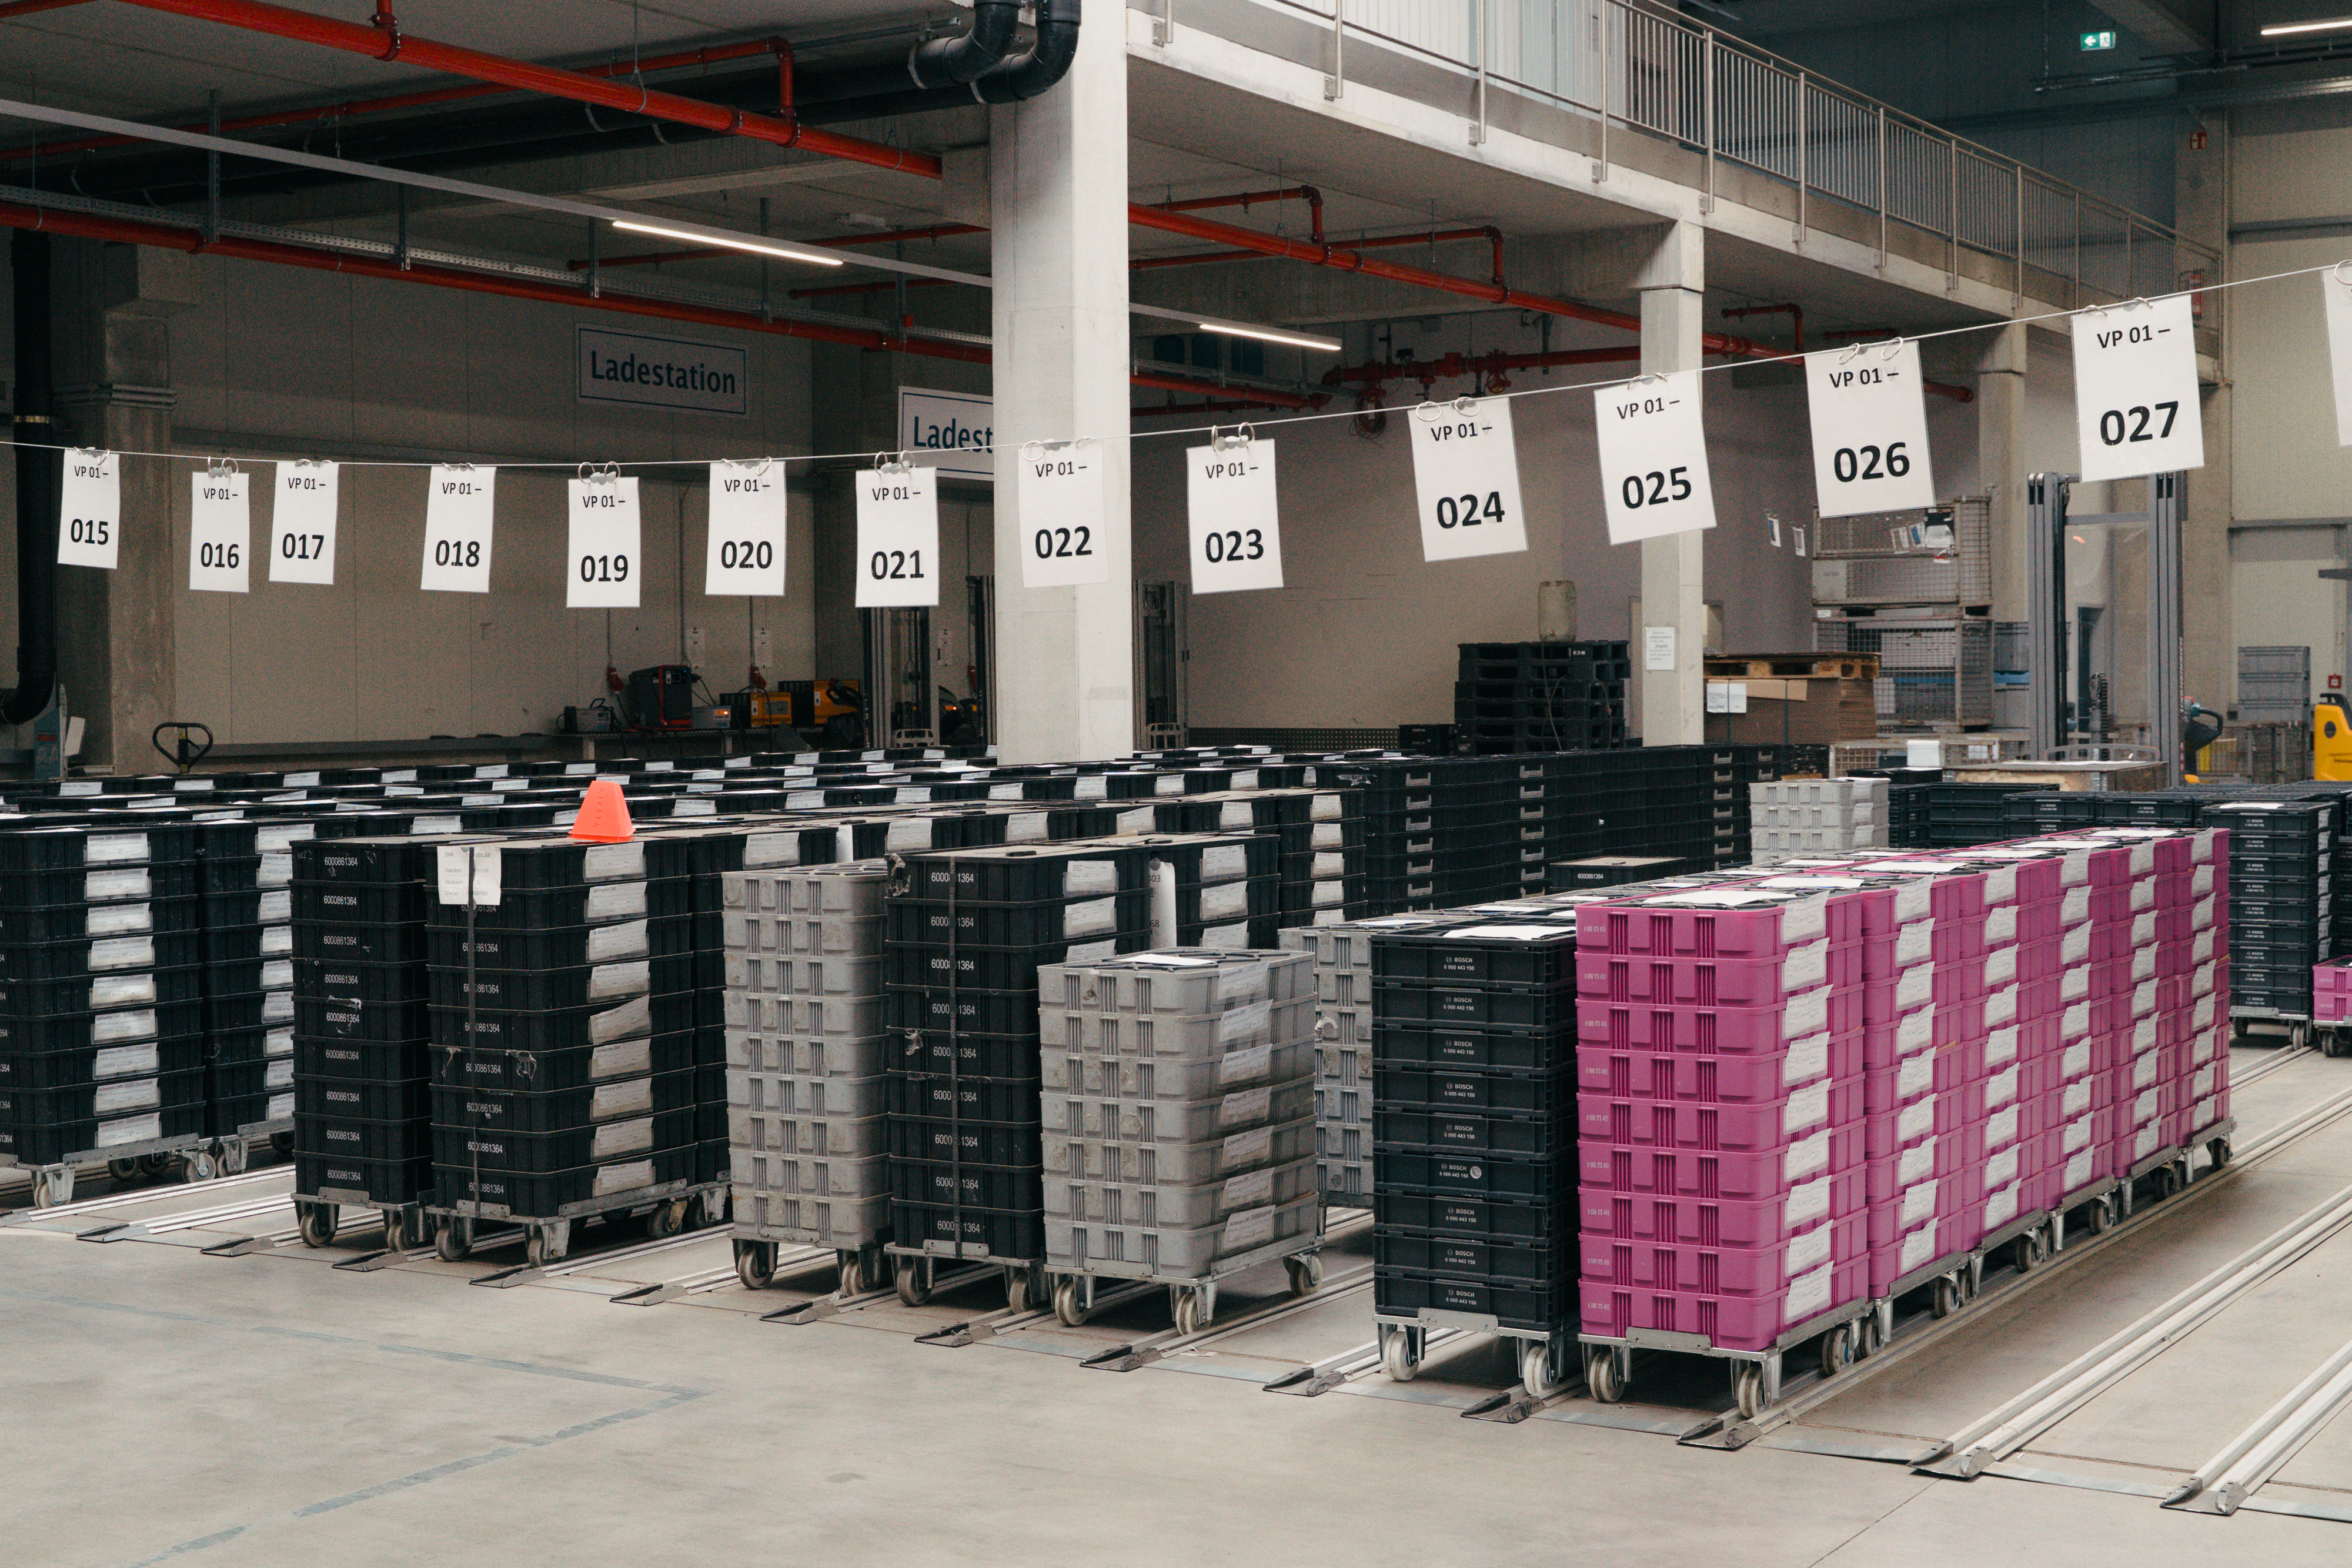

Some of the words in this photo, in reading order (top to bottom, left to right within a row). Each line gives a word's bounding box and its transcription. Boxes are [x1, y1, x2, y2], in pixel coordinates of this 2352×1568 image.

[2097, 330, 2123, 349] VP
[2129, 325, 2153, 343] 01
[592, 350, 736, 394] Ladestation
[1829, 371, 1854, 388] VP
[1859, 367, 1882, 385] 01
[1616, 403, 1639, 419] VP
[1644, 397, 1665, 414] 01
[2100, 400, 2179, 446] 027
[1430, 426, 1452, 442] VP
[1458, 422, 1478, 439] 01
[1035, 463, 1053, 477] VP
[1058, 461, 1074, 476] 01
[1834, 442, 1910, 483] 026
[74, 466, 86, 477] VP
[89, 466, 101, 479] 01
[1205, 464, 1224, 479] VP
[1228, 462, 1245, 477] 01
[288, 477, 302, 489] VP
[304, 478, 316, 490] 01
[442, 482, 456, 494] VP
[459, 483, 472, 494] 01
[724, 479, 740, 492] VP
[744, 479, 759, 492] 01
[1622, 466, 1692, 509] 025
[203, 488, 216, 499] VP
[218, 488, 230, 500] 01
[872, 487, 890, 501] VP
[893, 486, 909, 500] 01
[582, 496, 598, 508] VP
[601, 495, 615, 508] 01
[1436, 491, 1505, 529] 024
[71, 518, 109, 546] 015
[282, 533, 325, 560] 017
[1035, 526, 1093, 559] 022
[1205, 529, 1264, 563] 023
[201, 542, 239, 569] 016
[435, 540, 480, 567] 018
[721, 540, 773, 569] 020
[580, 554, 629, 583] 019
[871, 550, 924, 580] 021
[325, 857, 358, 867] 6000861364
[323, 895, 357, 905] 6000861364
[323, 935, 357, 945] 6000861364
[325, 974, 358, 984] 6000861364
[326, 1012, 360, 1023] 6000861364
[325, 1049, 359, 1060] 6000861364
[933, 1046, 977, 1058] 600061364
[326, 1091, 360, 1102] 6000861364
[934, 1089, 977, 1102] 600061364
[466, 1102, 502, 1114] 6000861364
[326, 1129, 360, 1141] 6000861364
[327, 1169, 361, 1181] 6000861364
[469, 1181, 505, 1194] 600861364
[937, 1220, 980, 1233] 600061364
